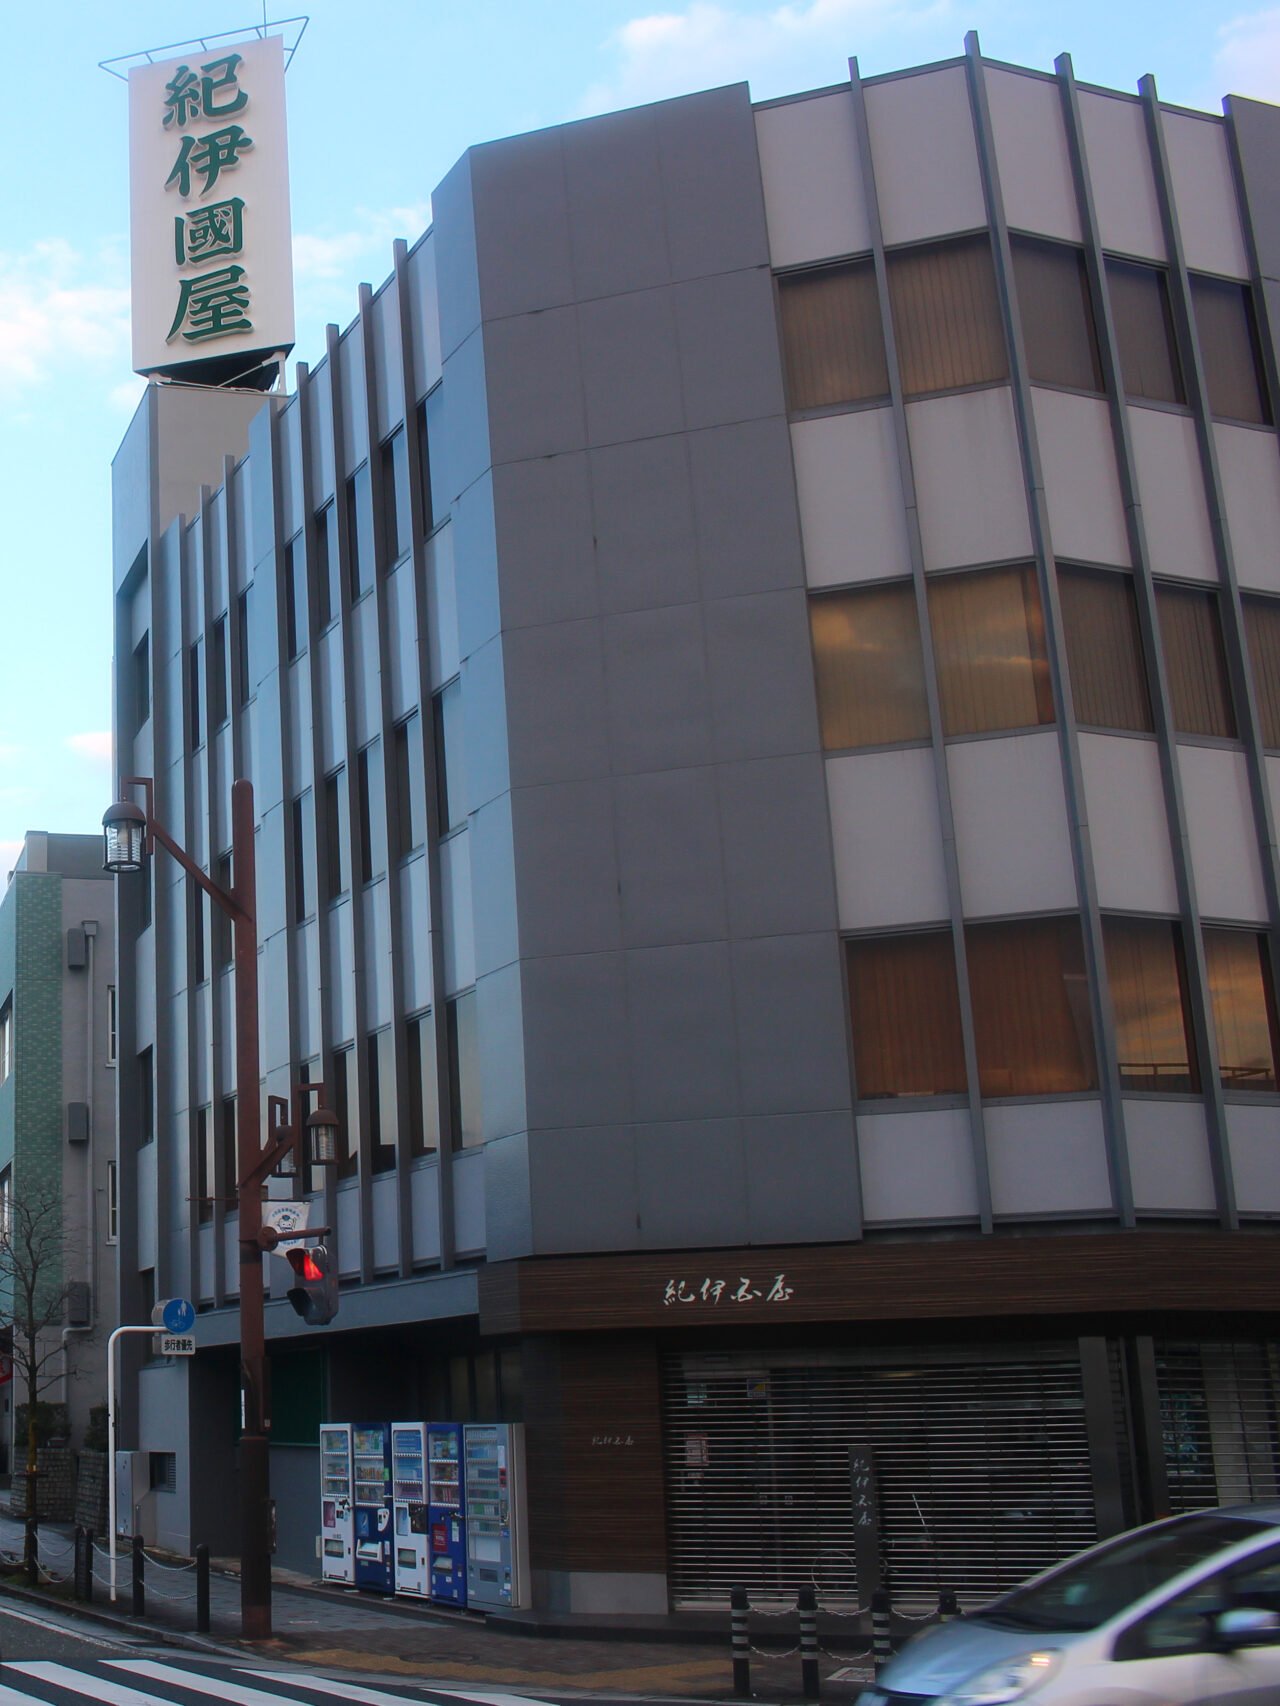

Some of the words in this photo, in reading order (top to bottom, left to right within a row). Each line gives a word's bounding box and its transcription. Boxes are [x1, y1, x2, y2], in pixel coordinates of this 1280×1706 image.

[161, 53, 253, 342] 紀伊國屋
[164, 1339, 193, 1351] 歩行者優先
